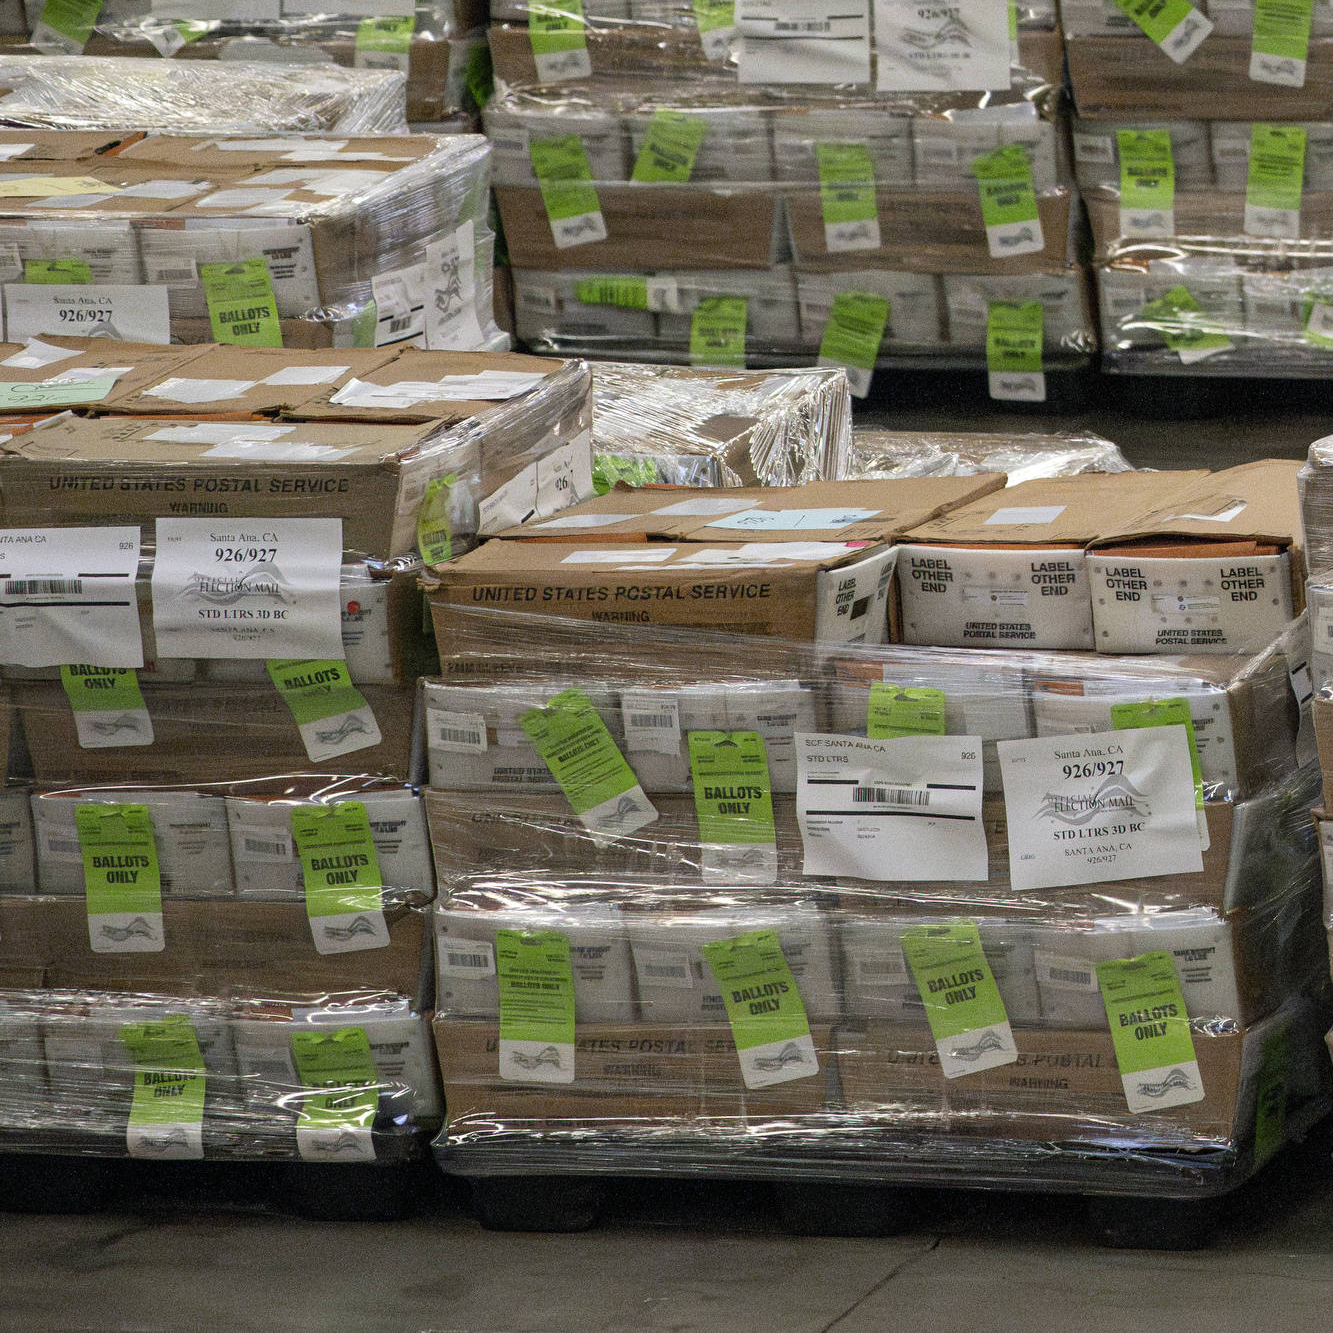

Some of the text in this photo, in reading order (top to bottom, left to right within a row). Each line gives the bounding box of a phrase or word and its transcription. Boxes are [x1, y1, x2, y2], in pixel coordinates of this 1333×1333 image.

[59, 310, 113, 322] 926/927
[219, 307, 271, 324] BALLOTS
[231, 323, 260, 336] ONLY
[49, 475, 349, 493] UNITED STATES POSTAL SERVICE
[168, 501, 228, 514] WARNING
[210, 532, 279, 544] Santa Ana, CA
[118, 541, 134, 550] 926
[215, 547, 278, 563] 926/927
[911, 557, 952, 571] LABEL
[1030, 561, 1075, 573] LABEL
[911, 569, 954, 582] OTHER
[1031, 572, 1076, 585] OTHER
[1105, 567, 1146, 579] LABEL
[1220, 566, 1264, 580] LABEL
[921, 581, 947, 594] END
[1041, 584, 1068, 596] END
[1105, 578, 1148, 590] OTHER
[1219, 578, 1266, 591] OTHER
[472, 583, 770, 601] UNITED STATES POSTAL SERVICE
[1115, 591, 1141, 602] END
[1230, 590, 1259, 602] END
[198, 609, 290, 621] STD LTRS 3D BC
[592, 610, 650, 623] WARNING
[965, 622, 1032, 631] UNITED STATES
[1156, 629, 1223, 637] UNITED STATES
[963, 630, 1037, 640] POSTAL SERVICE
[1154, 636, 1228, 645] POSTAL SERVICE
[84, 677, 116, 690] ONLY
[284, 667, 341, 688] BALLOTS
[824, 739, 886, 753] SANTA CA
[807, 755, 849, 763] STD LTRS
[961, 751, 976, 760] 926
[1054, 745, 1124, 761] Santa Ana, CA
[1063, 760, 1125, 780] 926/927
[704, 786, 762, 800] BALLOTS
[717, 802, 750, 815] ONLY
[1054, 796, 1136, 813] ELECTION MAIL
[1053, 822, 1146, 841] STD LTRS 3D BC
[1065, 842, 1133, 858] SANTA ANA, CA
[92, 855, 150, 868] BALLOTS
[310, 854, 369, 871] BALLOTS
[1087, 854, 1118, 865] 926/927
[106, 870, 143, 884] ONLY
[325, 869, 358, 885] ONLY
[927, 969, 984, 993] BALLOTS
[731, 982, 790, 1003] BALLOTS
[945, 984, 976, 1006] ONLY
[749, 998, 780, 1015] ONLY
[1119, 1003, 1179, 1027] BALLOTS
[1134, 1022, 1168, 1041] ONLY
